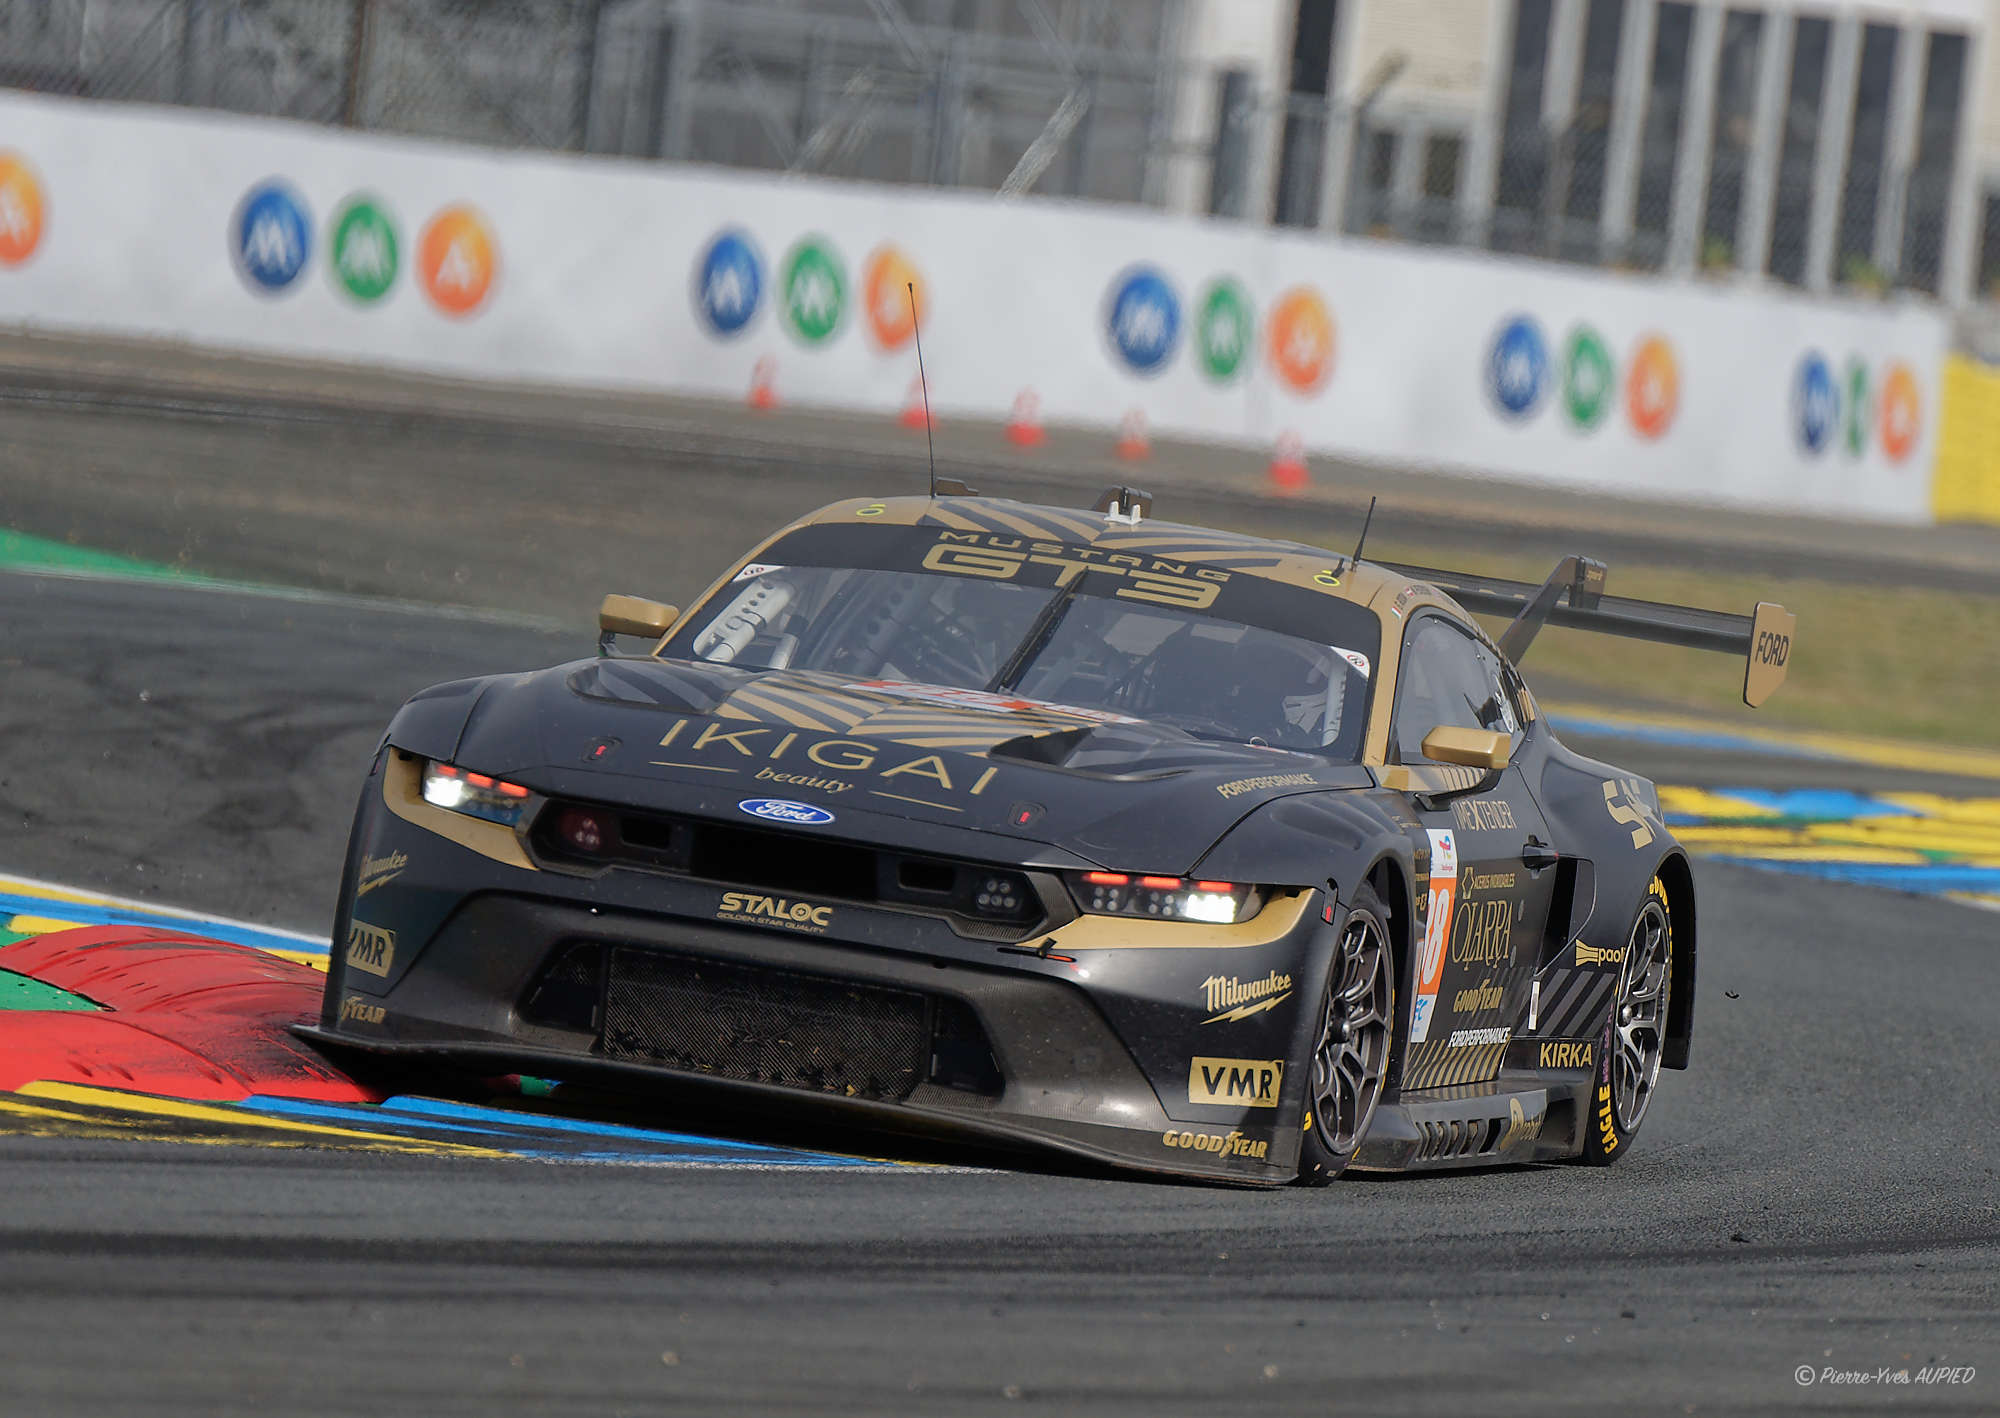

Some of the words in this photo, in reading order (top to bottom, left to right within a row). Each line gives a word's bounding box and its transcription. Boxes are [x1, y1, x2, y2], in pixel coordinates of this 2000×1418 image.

[939, 531, 1231, 582] MUSTANG
[922, 543, 1221, 608] GT3
[1755, 631, 1789, 666] FORD
[659, 719, 998, 795] IKIGAI
[754, 767, 854, 794] beauty
[756, 801, 816, 820] Ford
[716, 912, 757, 924] GOLDEN
[757, 917, 784, 928] STAR
[785, 921, 826, 935] QUALITY
[719, 892, 832, 926] STALOC
[1598, 947, 1626, 967] paol
[1200, 970, 1292, 1012] Milwaukee
[1453, 979, 1503, 1017] GOODYEAR
[1539, 1042, 1592, 1068] KIRKA
[1202, 1065, 1272, 1098] VMR
[1599, 1083, 1618, 1154] EAGLE
[1163, 1130, 1268, 1158] GOODYEAR
